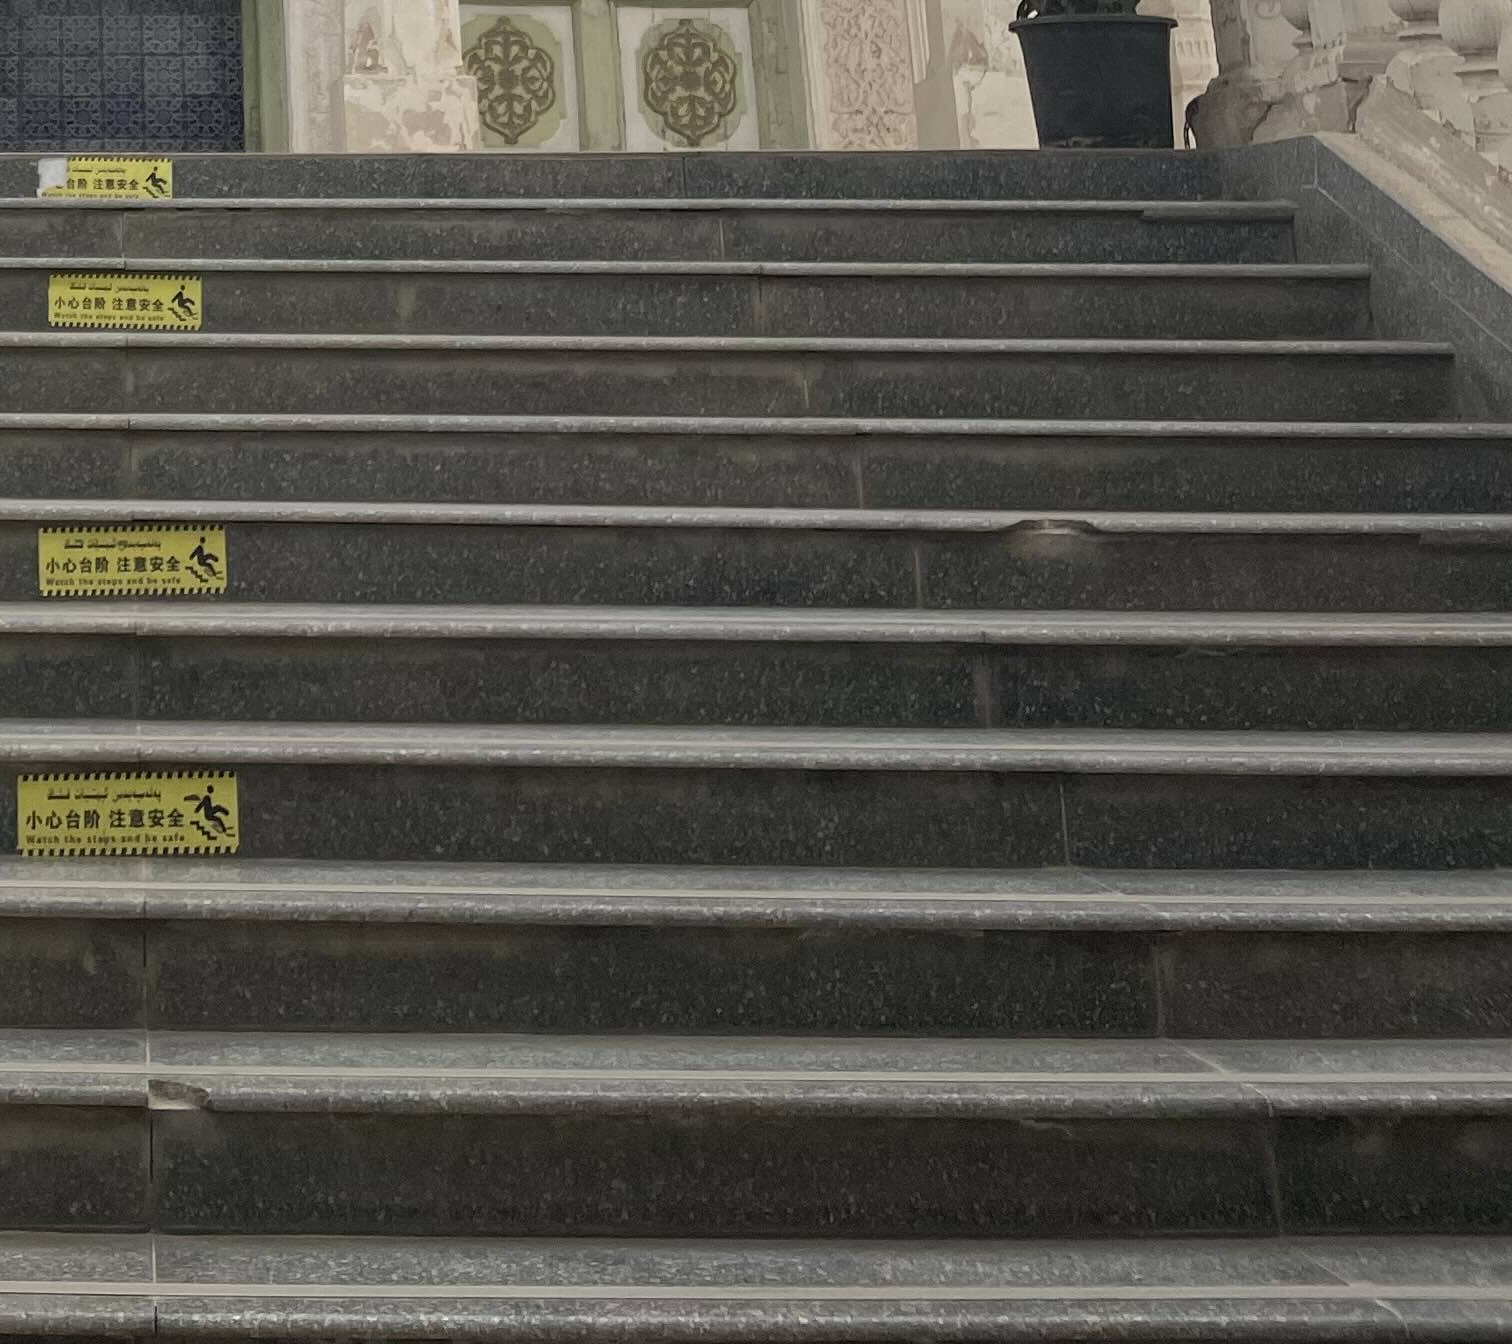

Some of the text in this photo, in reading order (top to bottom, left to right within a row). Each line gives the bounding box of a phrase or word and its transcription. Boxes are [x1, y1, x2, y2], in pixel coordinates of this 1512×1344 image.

[92, 178, 140, 191] 注意安全
[54, 297, 164, 312] 小心台阶 注意安全
[46, 556, 181, 574] 小心台阶 注意安全
[26, 808, 185, 830] 小心台阶 注意安全
[26, 835, 60, 844] Watch
[64, 834, 82, 843] the
[87, 834, 116, 846] steps
[121, 834, 140, 843] and
[163, 832, 185, 842] safe
